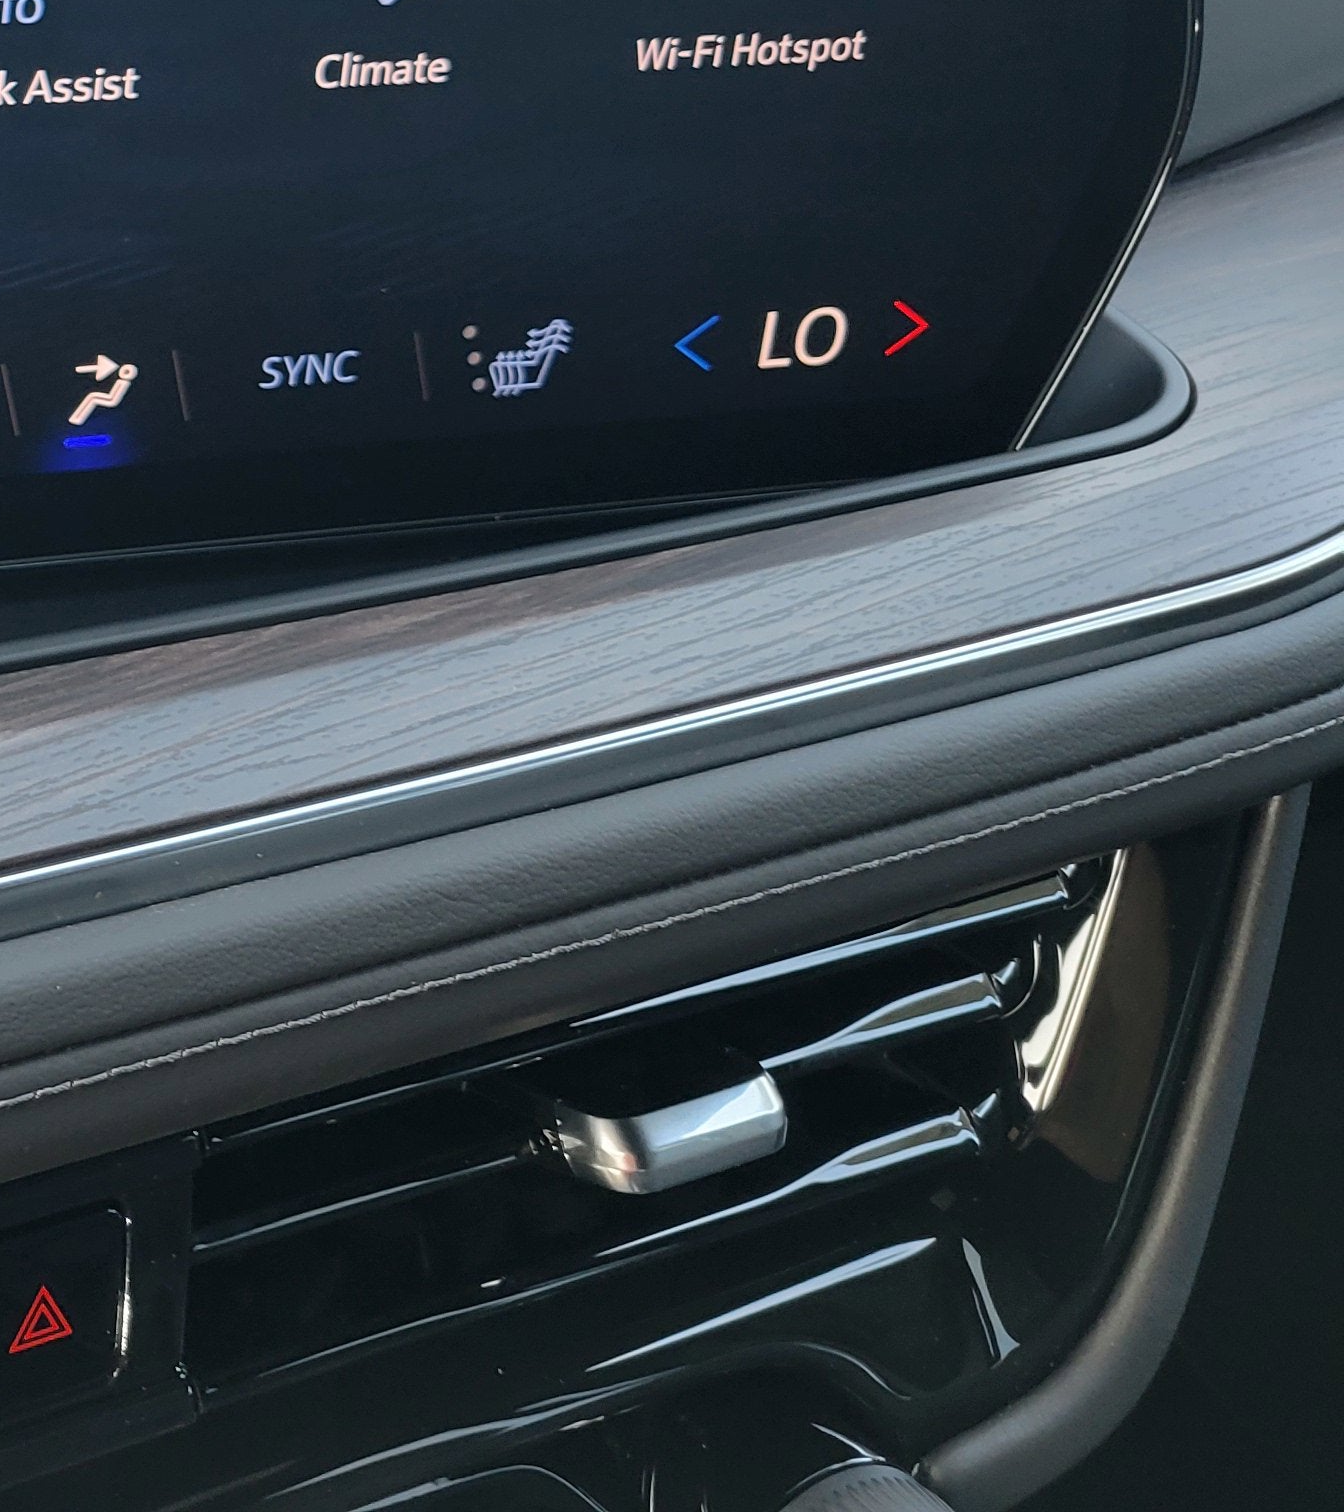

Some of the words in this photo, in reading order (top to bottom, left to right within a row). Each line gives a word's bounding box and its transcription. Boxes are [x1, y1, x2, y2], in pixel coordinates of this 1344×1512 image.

[636, 34, 726, 72] Wi-Fi
[731, 29, 867, 72] Hotspot
[22, 67, 141, 105] Assist
[314, 52, 451, 89] Climate
[757, 306, 847, 369] LO
[258, 350, 359, 389] SYNC
